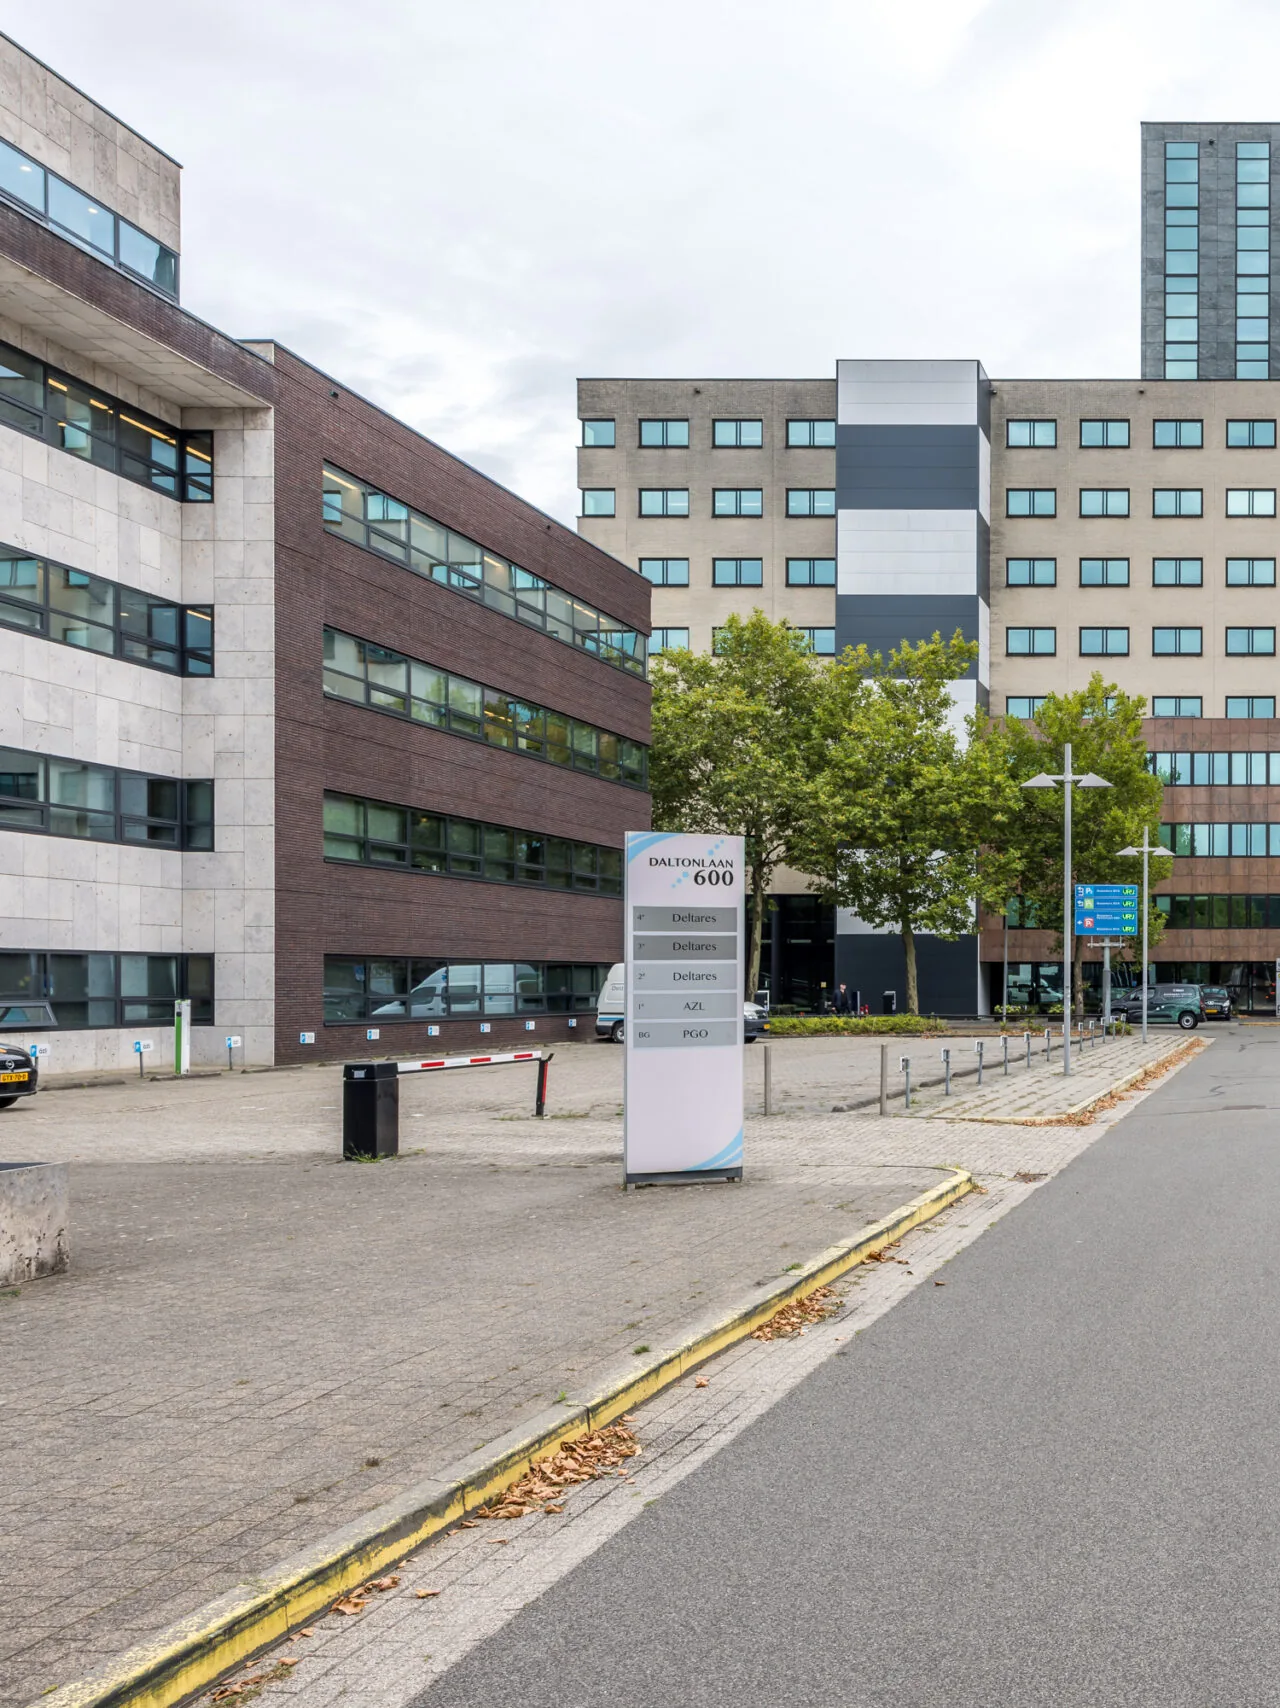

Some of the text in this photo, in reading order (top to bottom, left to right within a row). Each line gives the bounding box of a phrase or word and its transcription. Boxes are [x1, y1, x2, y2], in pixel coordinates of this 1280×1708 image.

[649, 857, 734, 868] DALTONLAAN
[693, 869, 734, 886] 600
[672, 913, 717, 923] Deltares
[672, 941, 717, 951] Deltares
[673, 971, 717, 981] Deltares
[683, 1001, 705, 1011] AZL
[683, 1029, 709, 1039] PGO
